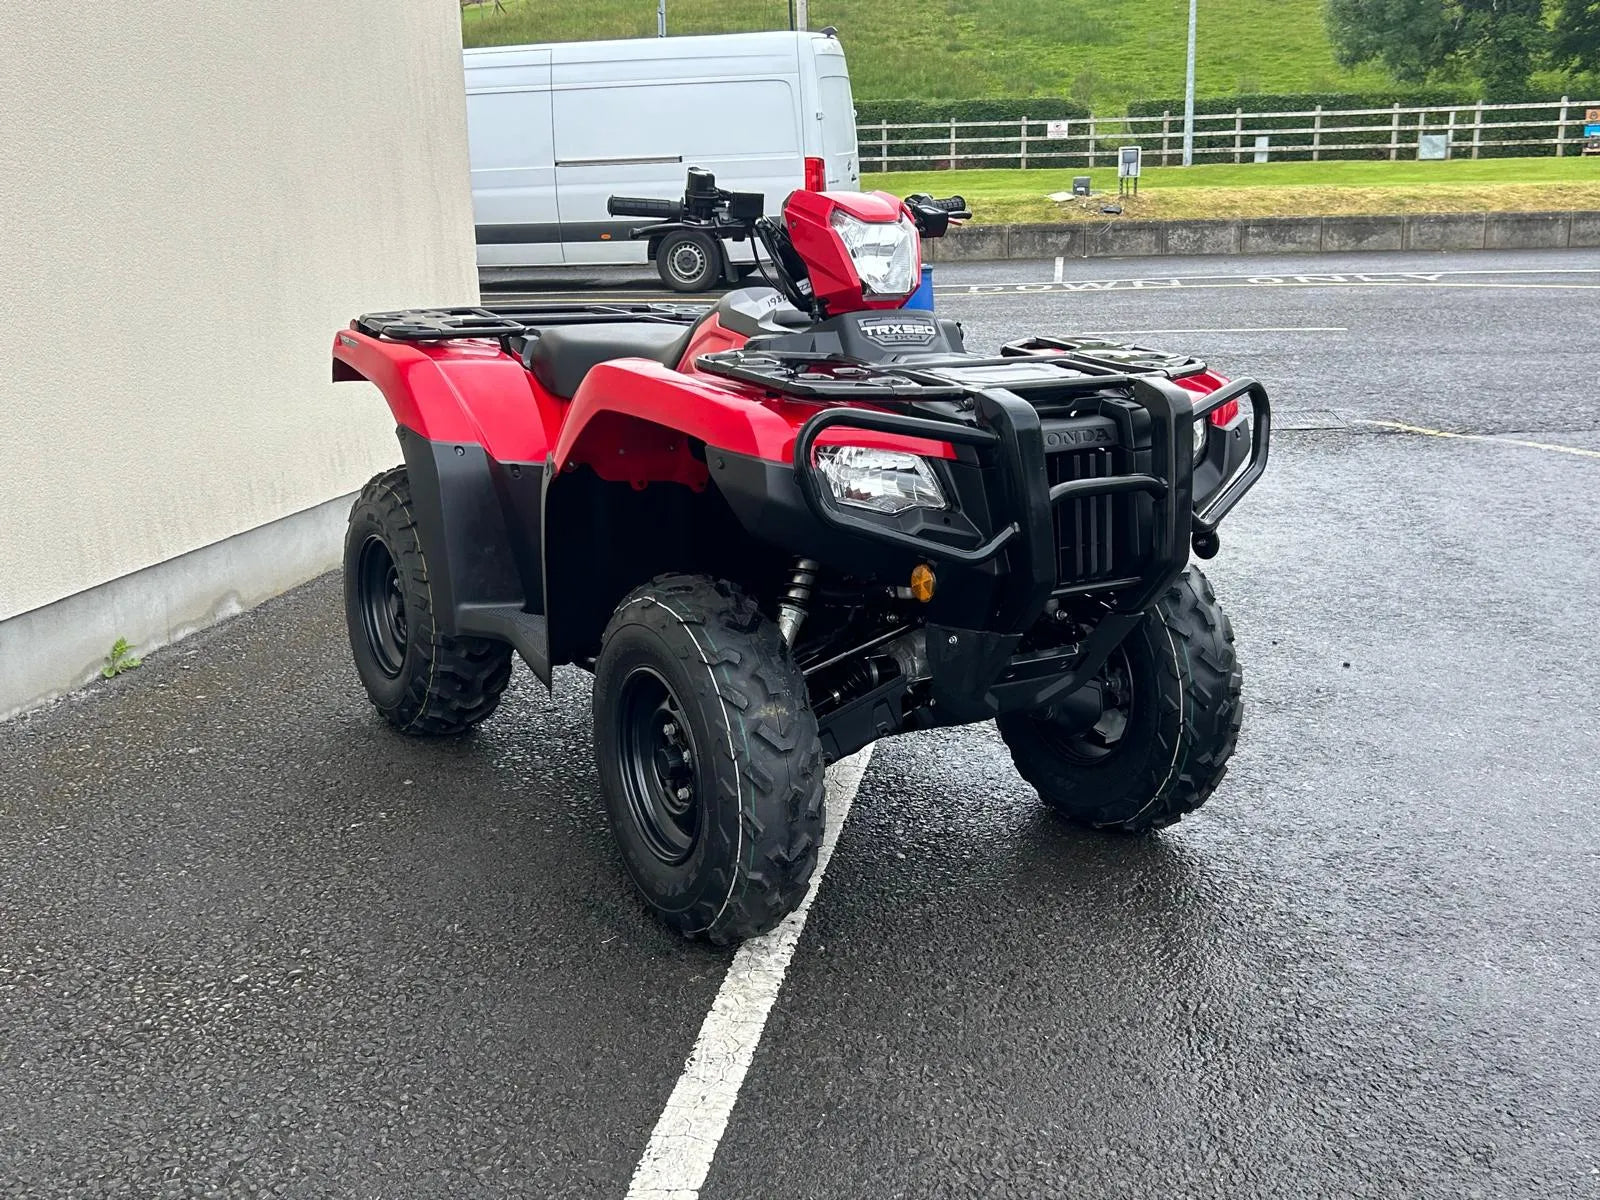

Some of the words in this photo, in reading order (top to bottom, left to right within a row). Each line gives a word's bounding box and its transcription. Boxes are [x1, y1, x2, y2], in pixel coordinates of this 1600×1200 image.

[968, 279, 1182, 294] DOWN
[1247, 274, 1444, 284] ONLY
[861, 324, 936, 336] TRX520
[1044, 427, 1112, 447] ONDA
